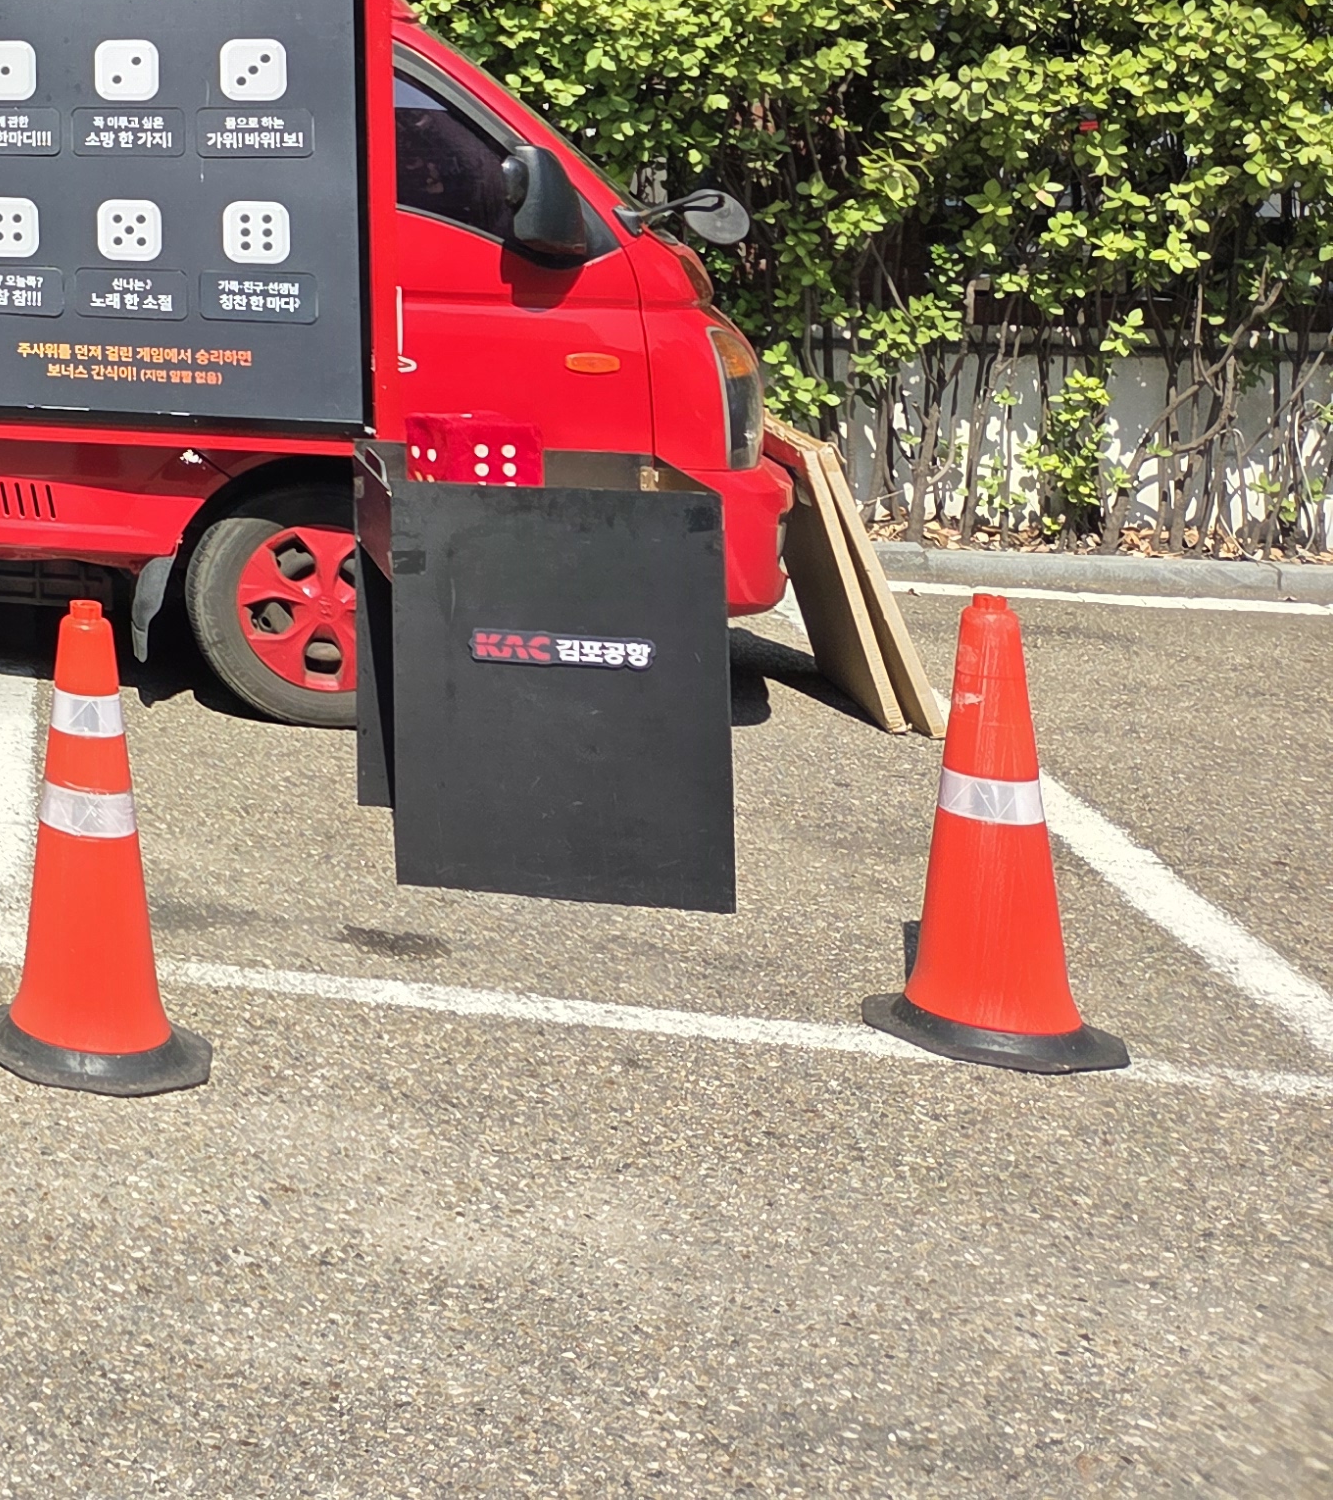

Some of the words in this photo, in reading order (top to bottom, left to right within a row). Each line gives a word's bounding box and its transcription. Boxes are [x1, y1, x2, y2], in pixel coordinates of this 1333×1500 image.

[7, 116, 29, 128] 관한
[92, 116, 106, 130] 꼭
[106, 117, 140, 129] 이루고
[141, 117, 165, 129] 싶은
[224, 116, 259, 130] 몸으로
[260, 116, 285, 129] 하는
[84, 131, 115, 148] 소망
[118, 131, 134, 148] 한
[137, 131, 173, 149] 가지!
[90, 293, 120, 309] 노래
[124, 293, 140, 310] 한
[142, 294, 173, 312] 소절
[219, 294, 248, 311] 칭찬
[17, 342, 72, 359] 주사위를
[105, 345, 133, 362] 걸린
[136, 346, 192, 364] 게임에서
[195, 348, 253, 367] 승리하면
[46, 363, 89, 379] 보너스
[90, 364, 137, 382] 간식이!
[475, 632, 551, 660] KAC
[555, 639, 651, 669] 김포공항
